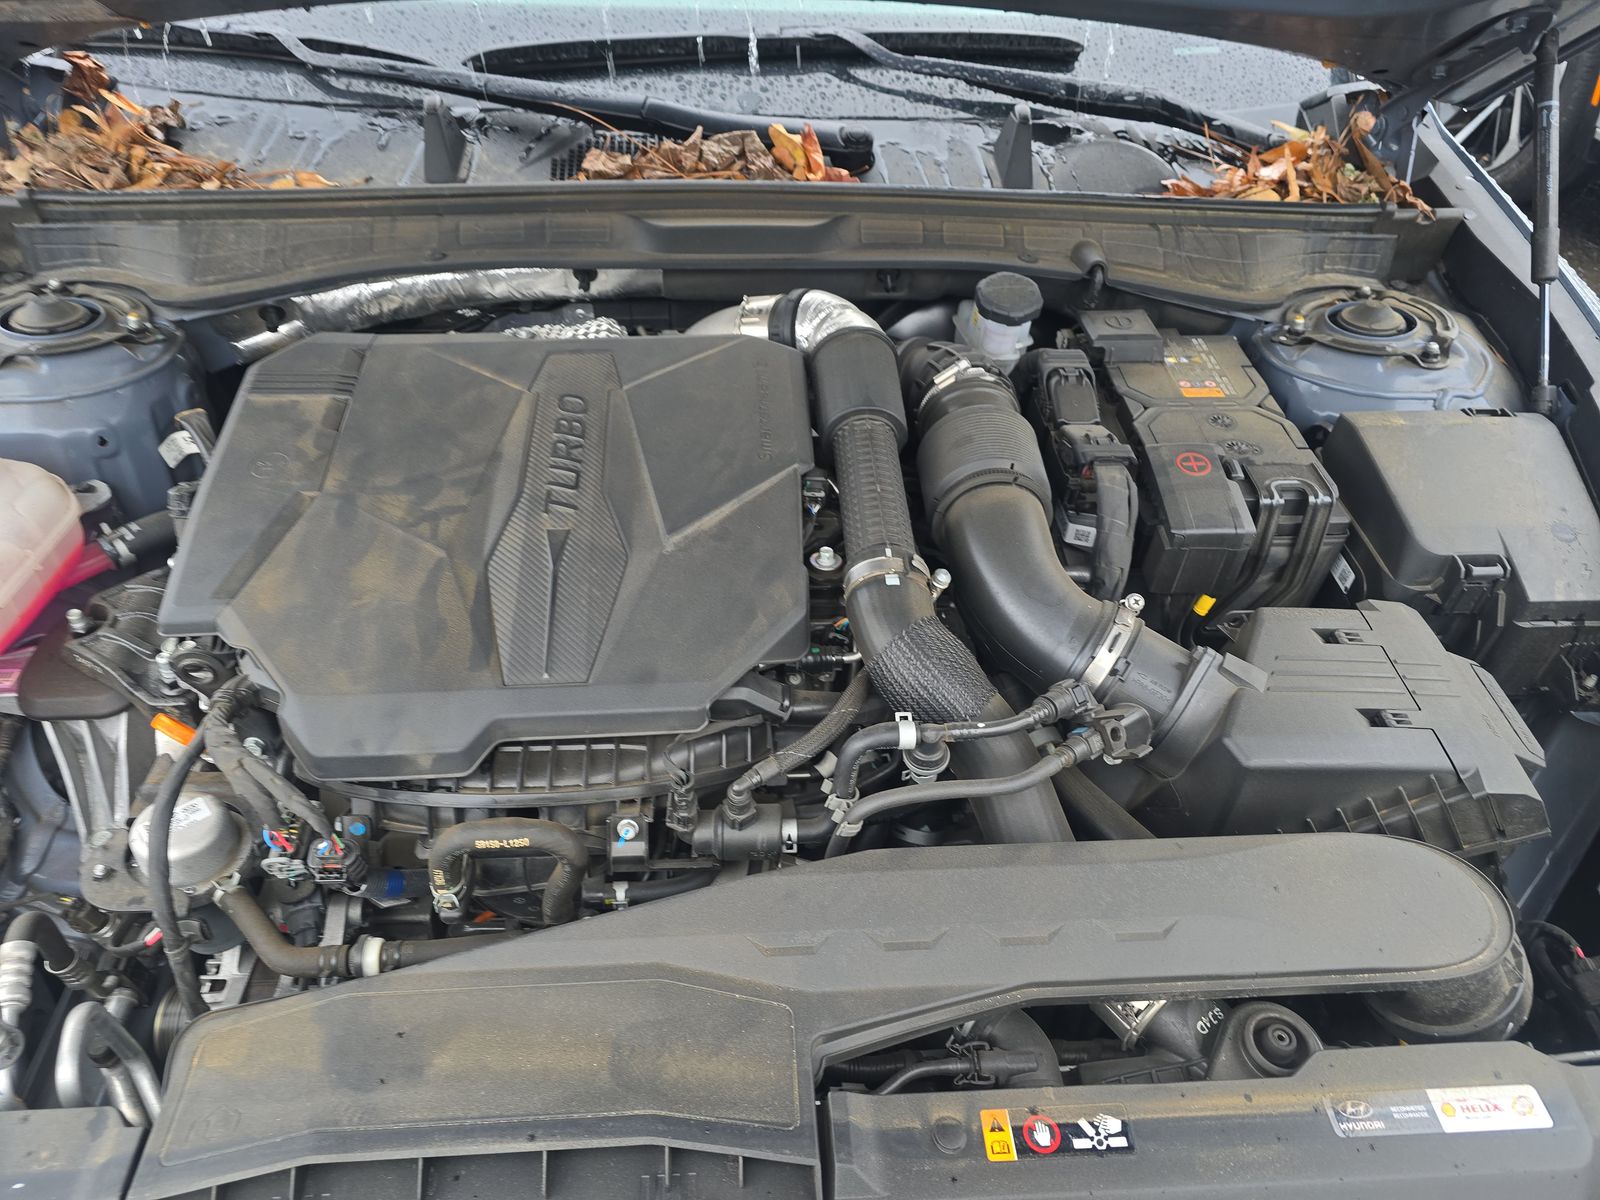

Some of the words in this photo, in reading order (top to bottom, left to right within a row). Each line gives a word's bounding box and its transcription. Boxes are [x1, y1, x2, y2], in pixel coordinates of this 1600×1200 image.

[543, 394, 586, 516] TURBO
[1460, 1103, 1504, 1113] HELIX
[1339, 1120, 1386, 1132] HYUNDAI
